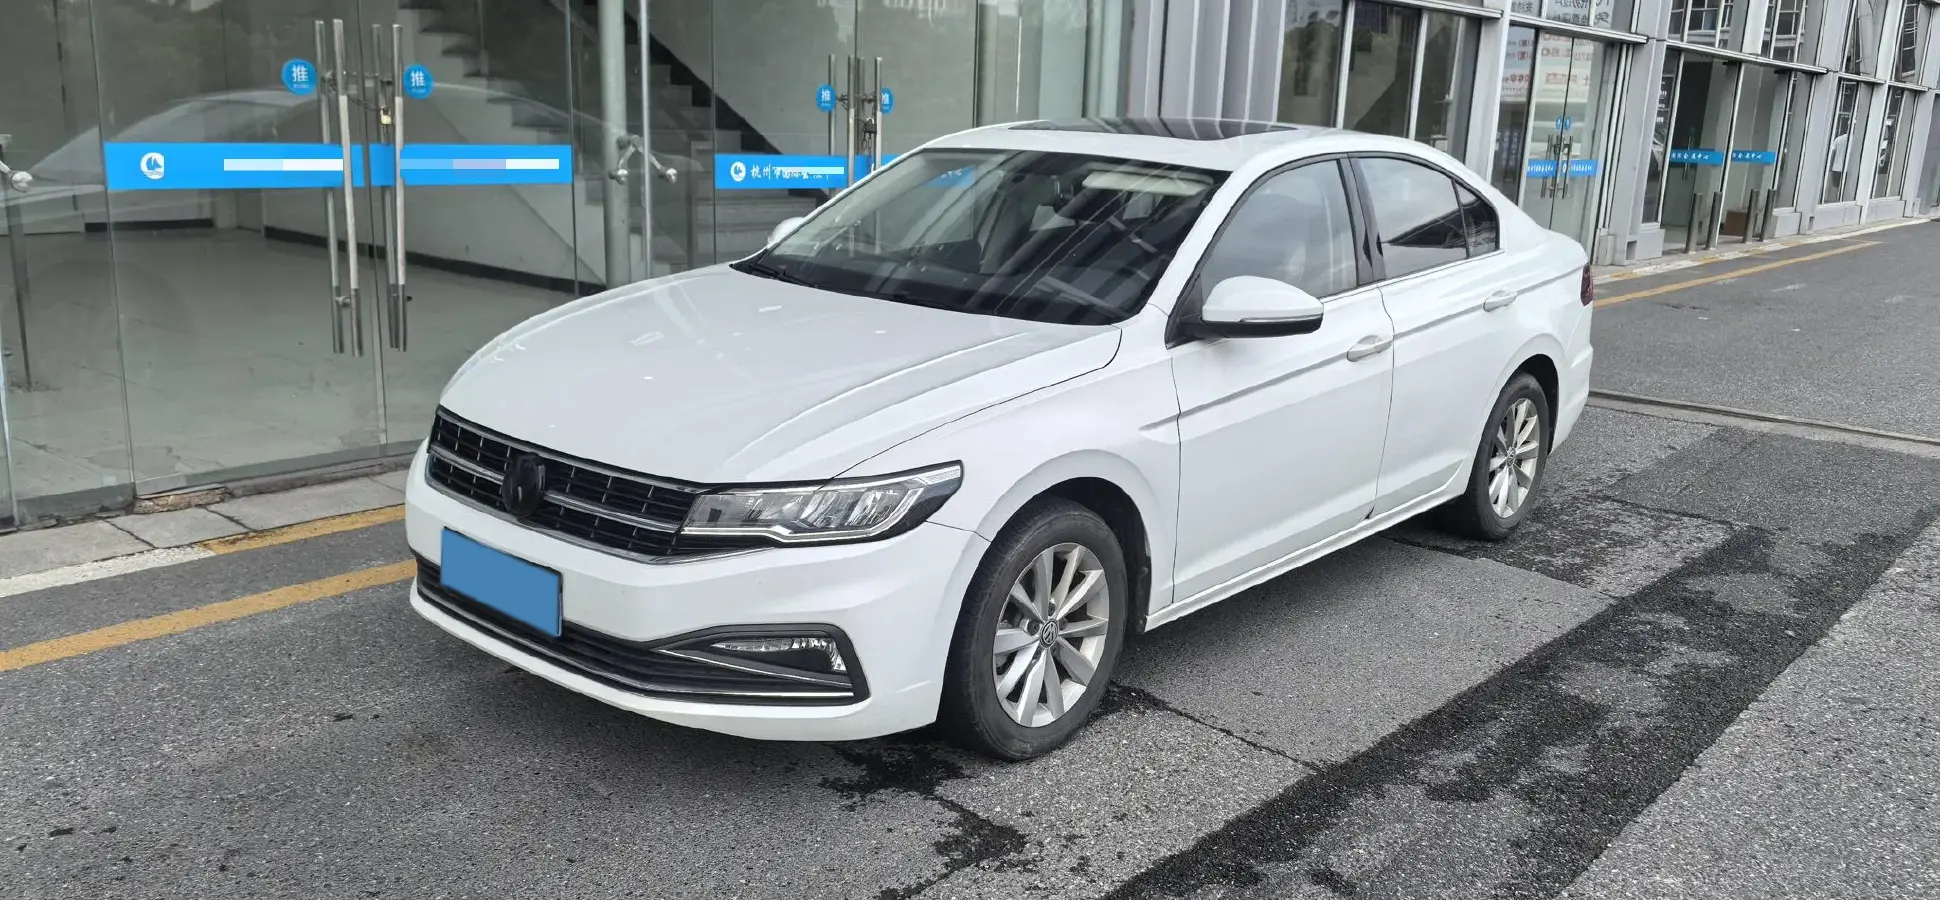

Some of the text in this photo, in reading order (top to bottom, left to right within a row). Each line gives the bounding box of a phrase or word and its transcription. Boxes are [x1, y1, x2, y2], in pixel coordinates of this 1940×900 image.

[291, 64, 309, 82] 推
[410, 70, 425, 87] 推
[821, 88, 831, 102] 推
